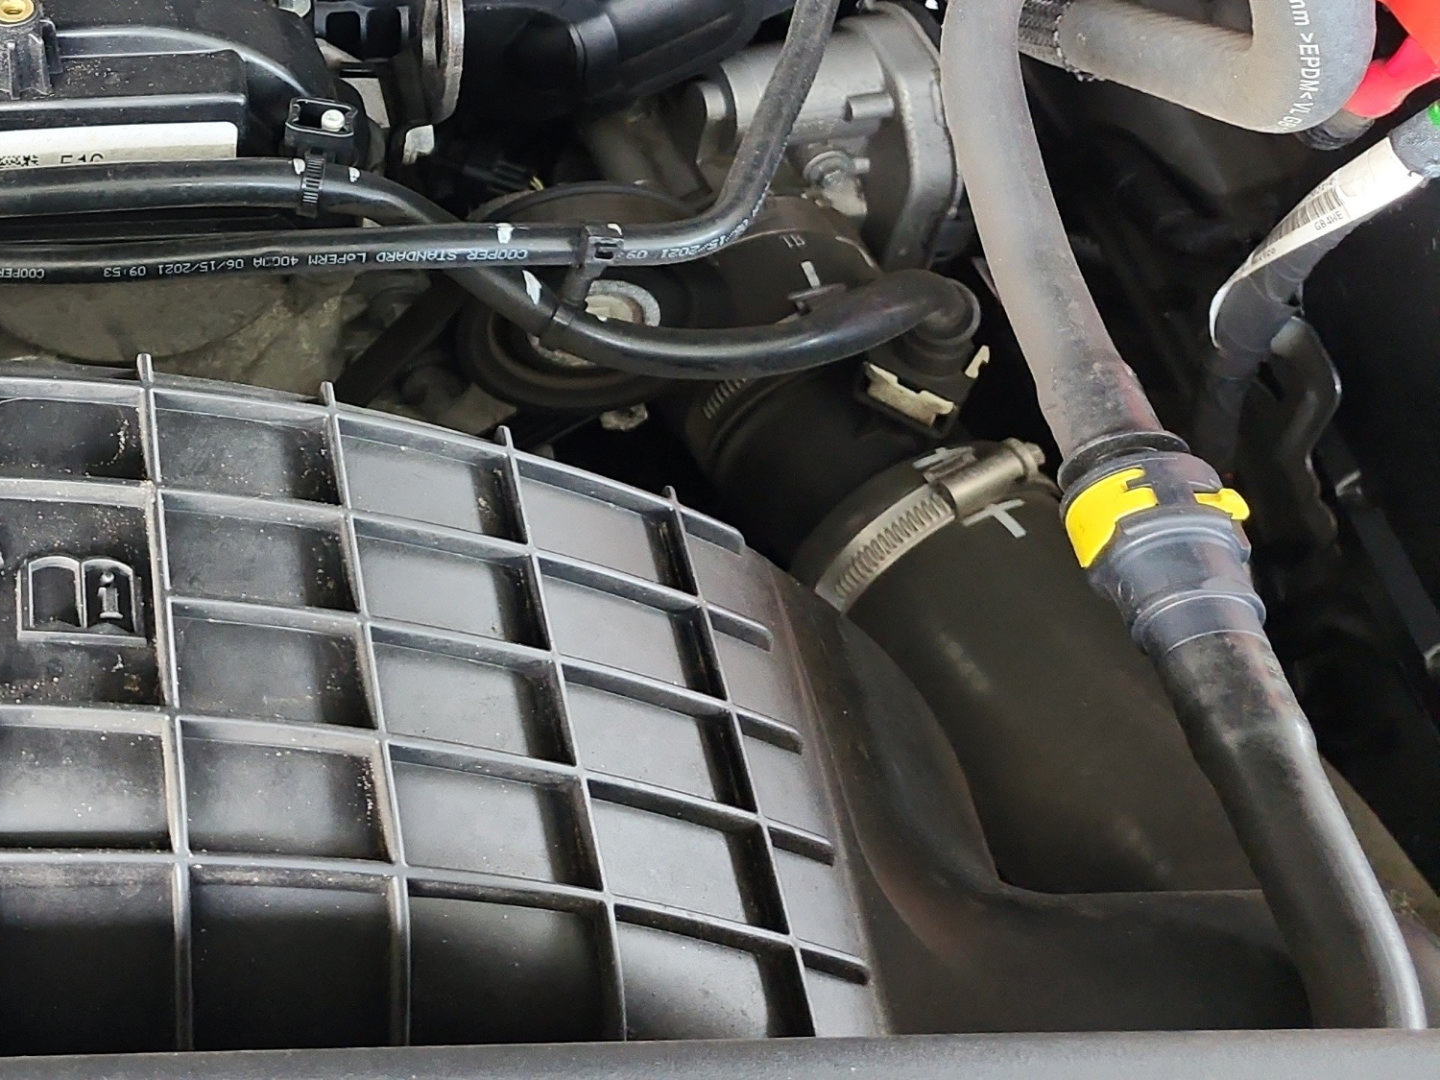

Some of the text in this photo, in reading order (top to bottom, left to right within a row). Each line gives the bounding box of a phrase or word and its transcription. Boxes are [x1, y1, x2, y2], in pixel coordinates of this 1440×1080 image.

[308, 252, 366, 265] LoPERM
[376, 250, 457, 262] STANDARD
[466, 248, 528, 260] COOPER
[103, 265, 146, 278] 09:53
[158, 257, 244, 275] 06/15/2021
